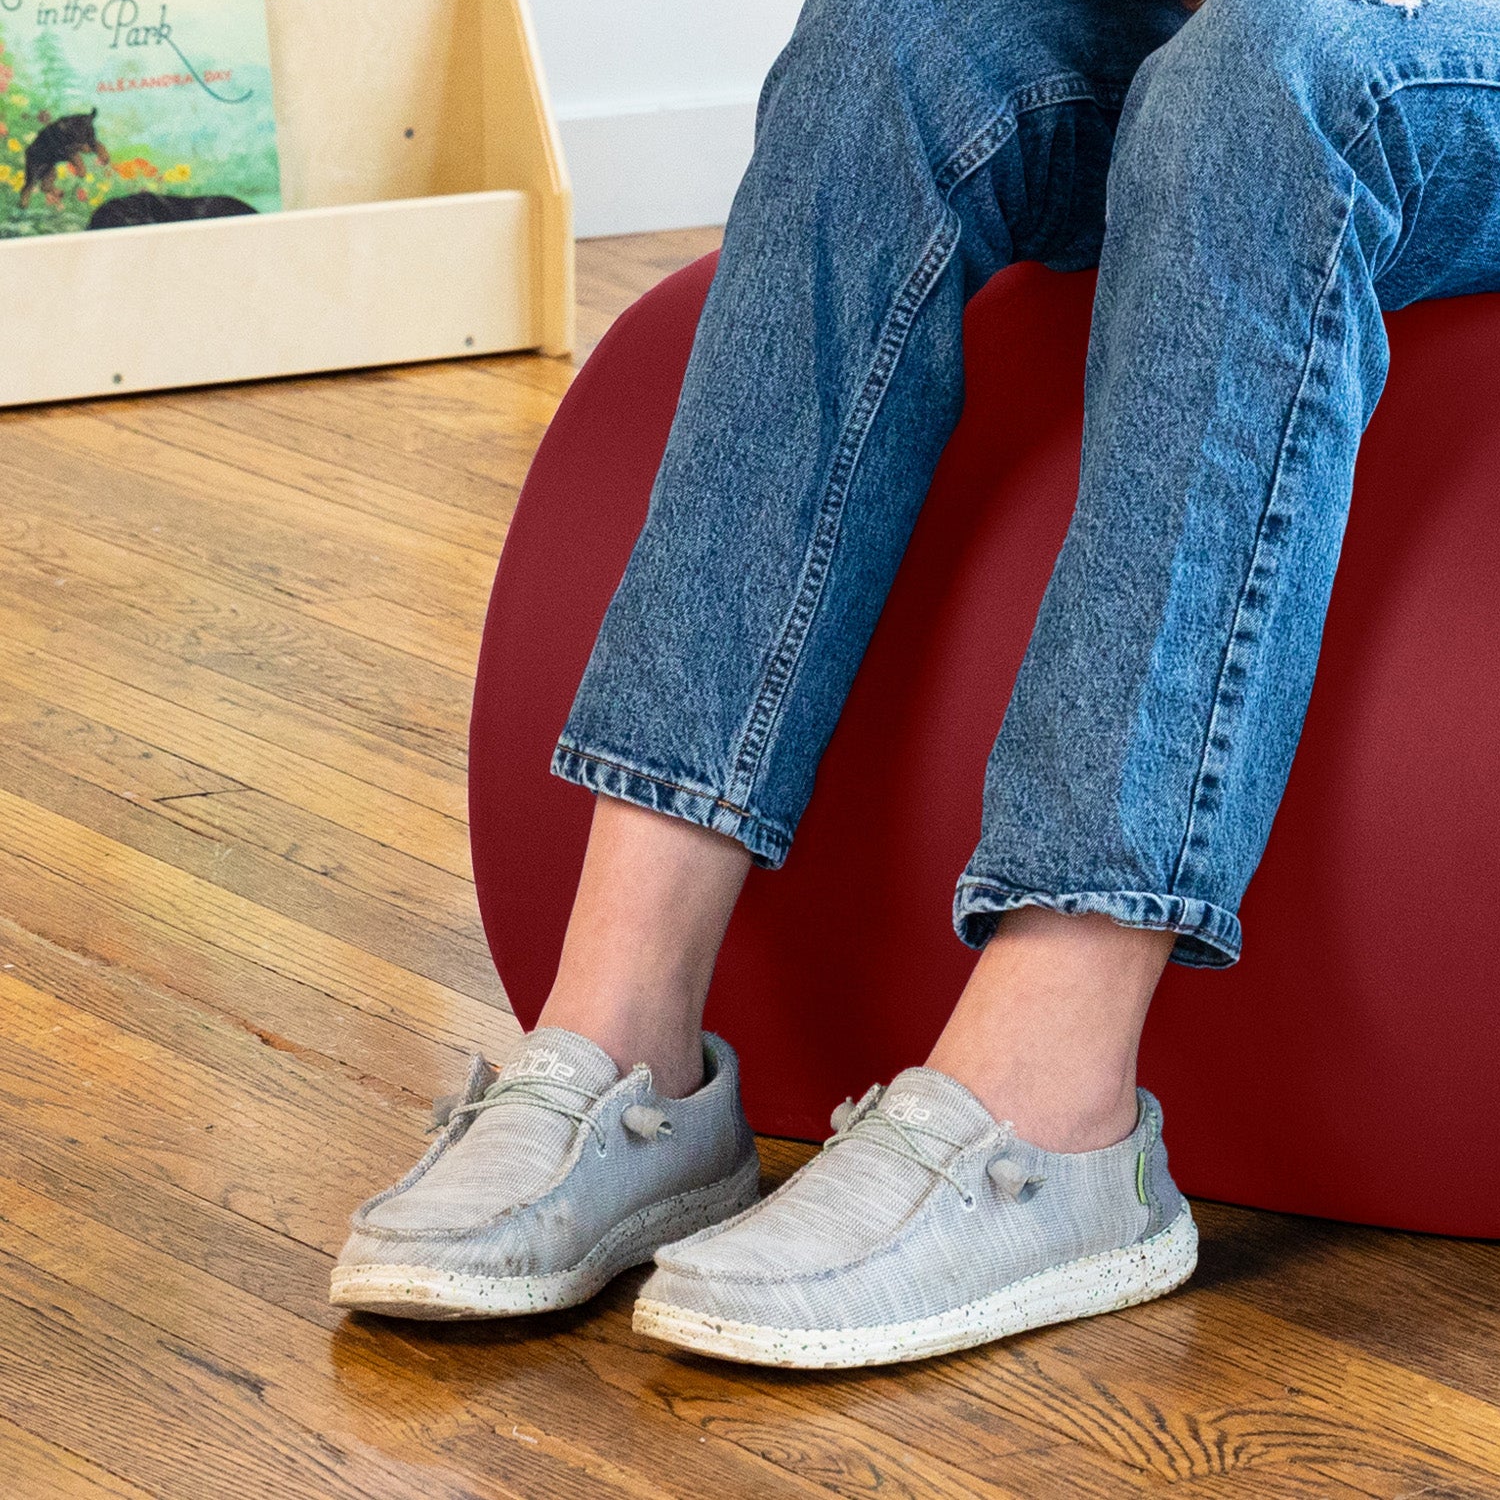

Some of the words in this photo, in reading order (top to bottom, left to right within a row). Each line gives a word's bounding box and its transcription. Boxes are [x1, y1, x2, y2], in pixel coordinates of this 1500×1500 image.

[36, 2, 58, 26] in
[97, 73, 195, 93] ALEXANDRA
[204, 69, 233, 83] DAY
